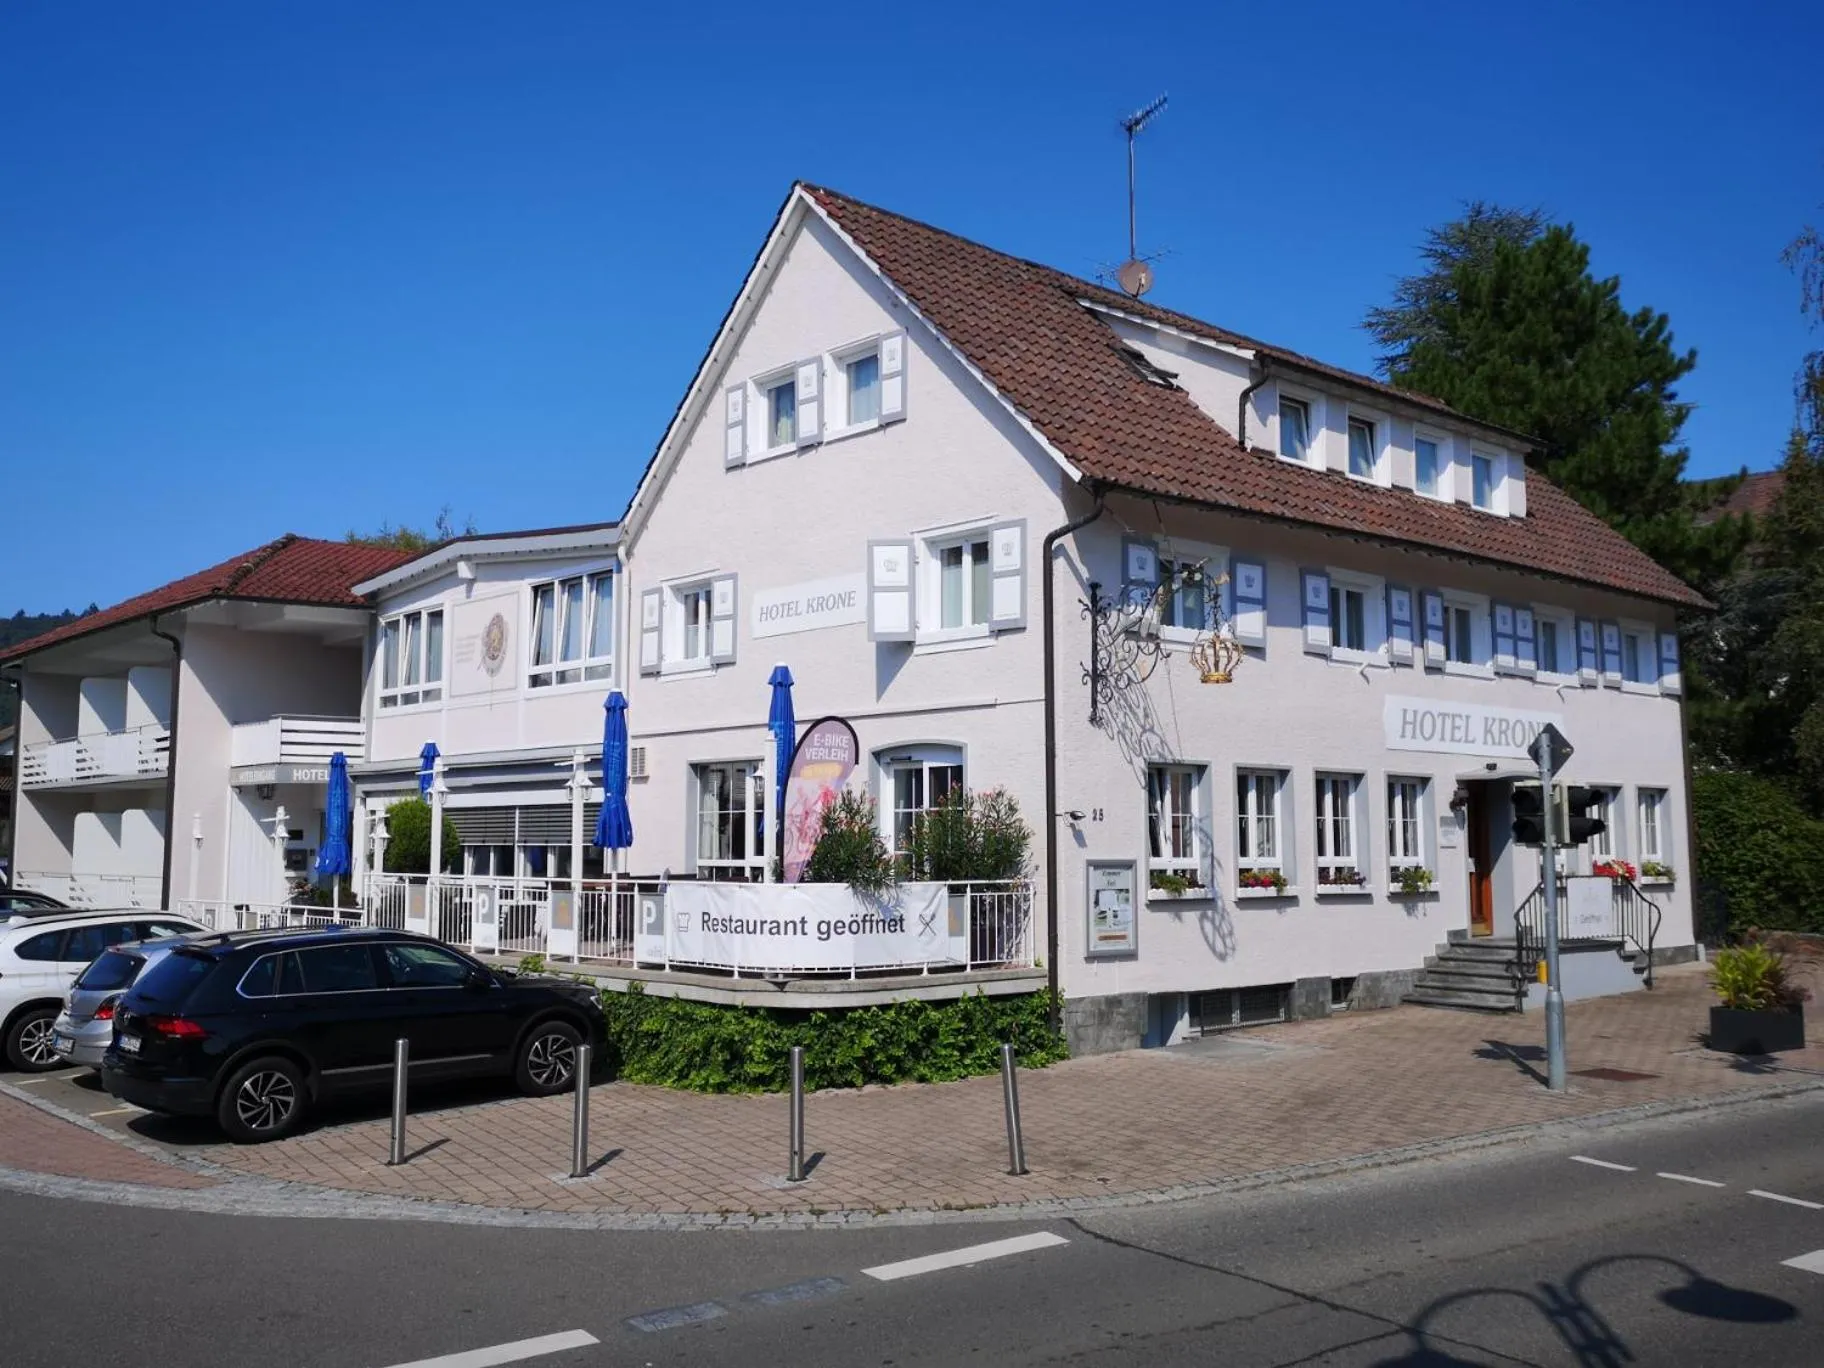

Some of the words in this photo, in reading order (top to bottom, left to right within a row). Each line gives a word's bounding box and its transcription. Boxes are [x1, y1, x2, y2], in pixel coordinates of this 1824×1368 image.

[759, 600, 802, 622] HOTEL
[806, 590, 856, 614] KRONE
[813, 733, 849, 748] E-BIKE
[1400, 708, 1476, 744] HOTEL
[1482, 716, 1547, 748] KRON
[805, 747, 849, 761] VERLEIH
[292, 769, 328, 781] HOTEL
[479, 893, 489, 923] P
[642, 900, 656, 935] P
[701, 912, 808, 936] Restaurant
[816, 913, 906, 941] geöffnet
